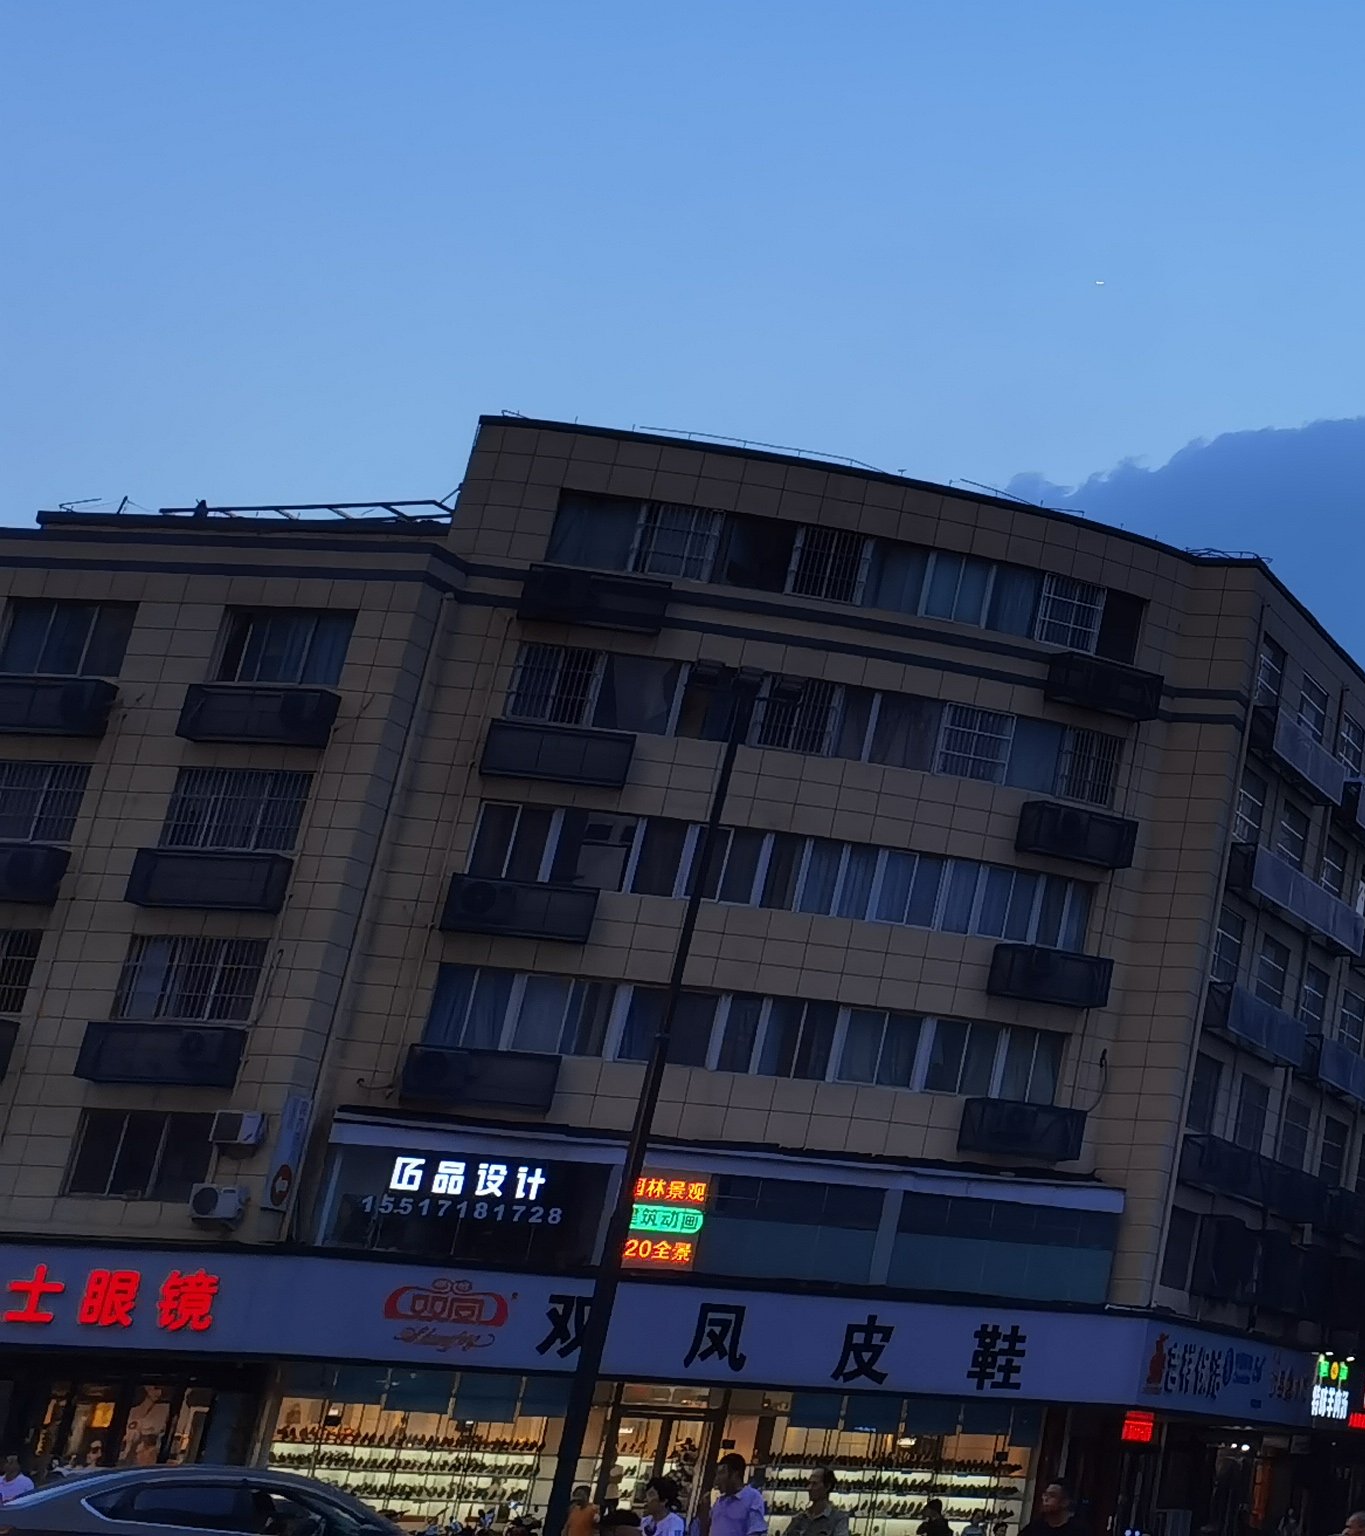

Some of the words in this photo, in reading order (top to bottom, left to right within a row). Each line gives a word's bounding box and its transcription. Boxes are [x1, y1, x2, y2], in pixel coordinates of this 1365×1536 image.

[361, 1194, 563, 1225] 15517181728
[3, 1262, 220, 1332] 士眼镜
[536, 1293, 1027, 1391] 双凤皮鞋
